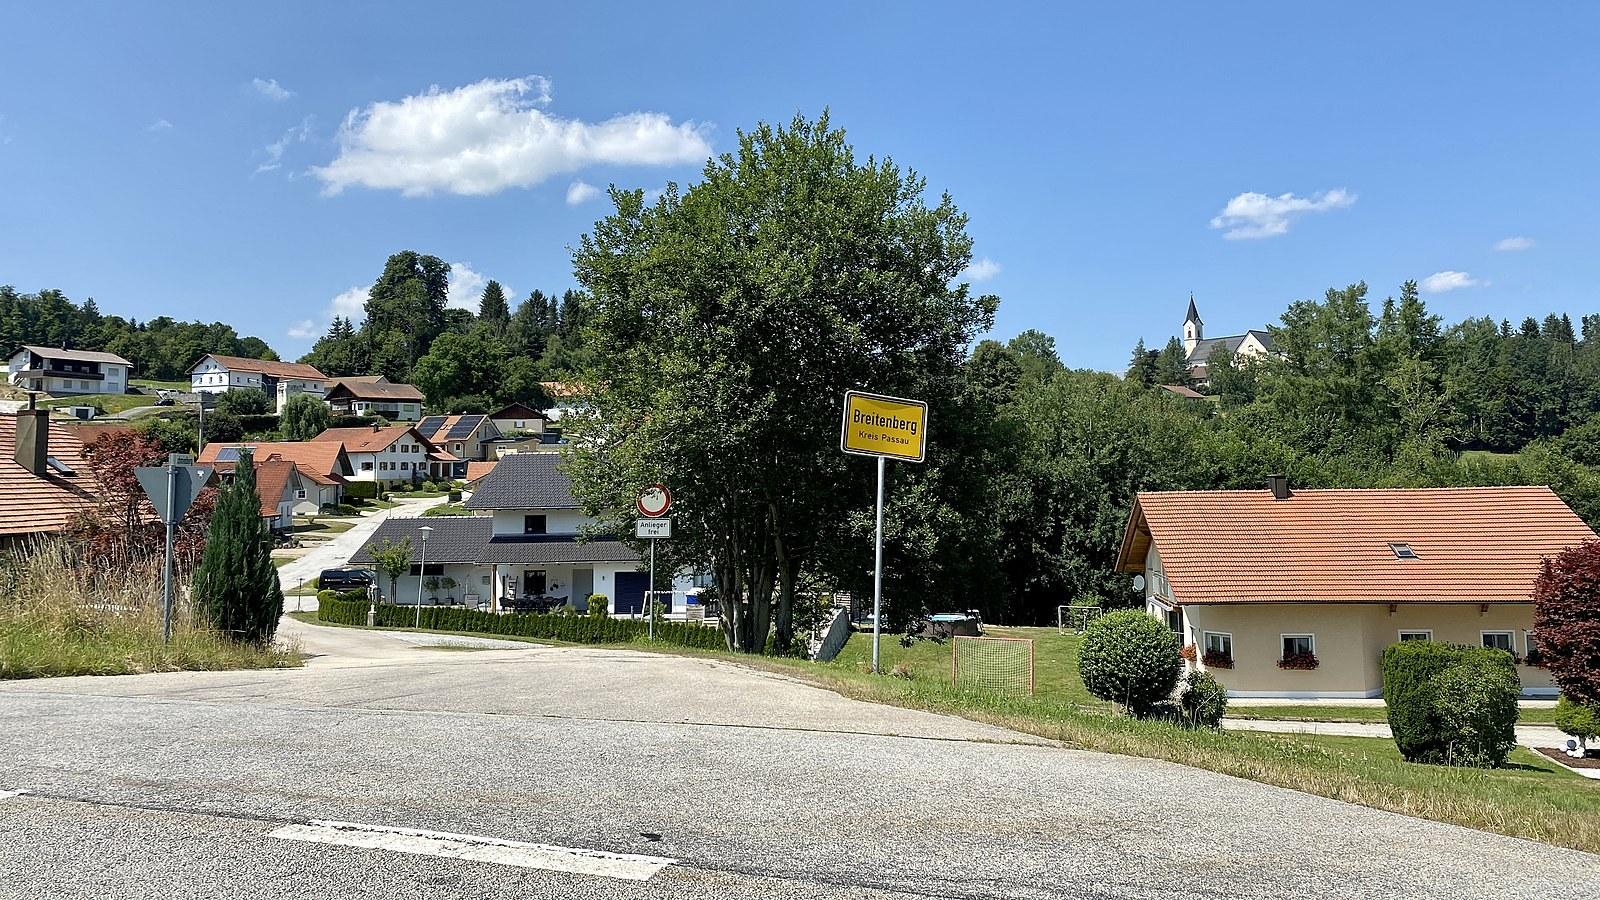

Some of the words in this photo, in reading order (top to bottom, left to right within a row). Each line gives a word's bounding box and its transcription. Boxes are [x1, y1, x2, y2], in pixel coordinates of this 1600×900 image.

[854, 409, 917, 435] Breitenberg
[858, 430, 879, 440] Kreis
[881, 434, 909, 444] Passau
